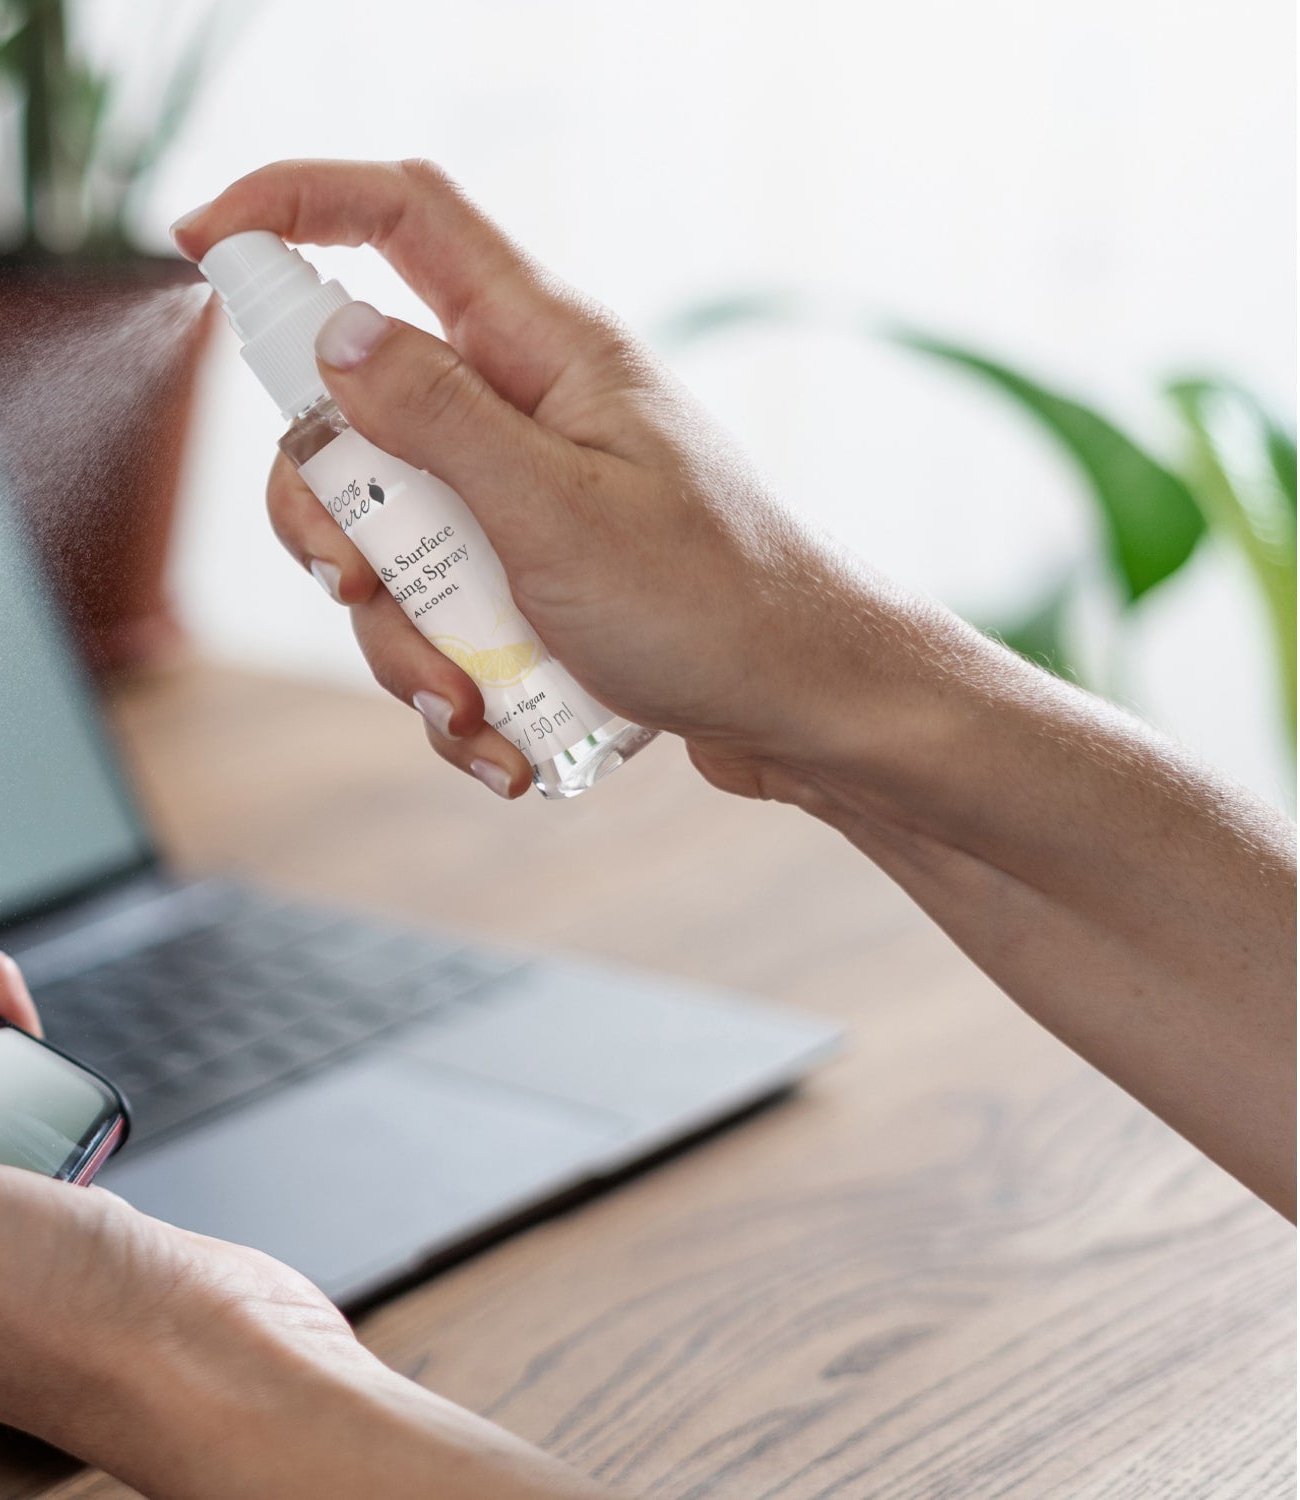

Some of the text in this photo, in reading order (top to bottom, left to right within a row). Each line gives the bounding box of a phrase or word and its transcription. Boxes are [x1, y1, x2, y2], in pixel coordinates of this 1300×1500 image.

[327, 479, 361, 518] 100%
[380, 525, 455, 583] & Surface
[422, 544, 469, 582] Spray
[413, 583, 460, 619] ALCOHOL
[516, 691, 547, 715] Vegan
[530, 716, 554, 740] 50
[553, 701, 575, 727] ml
